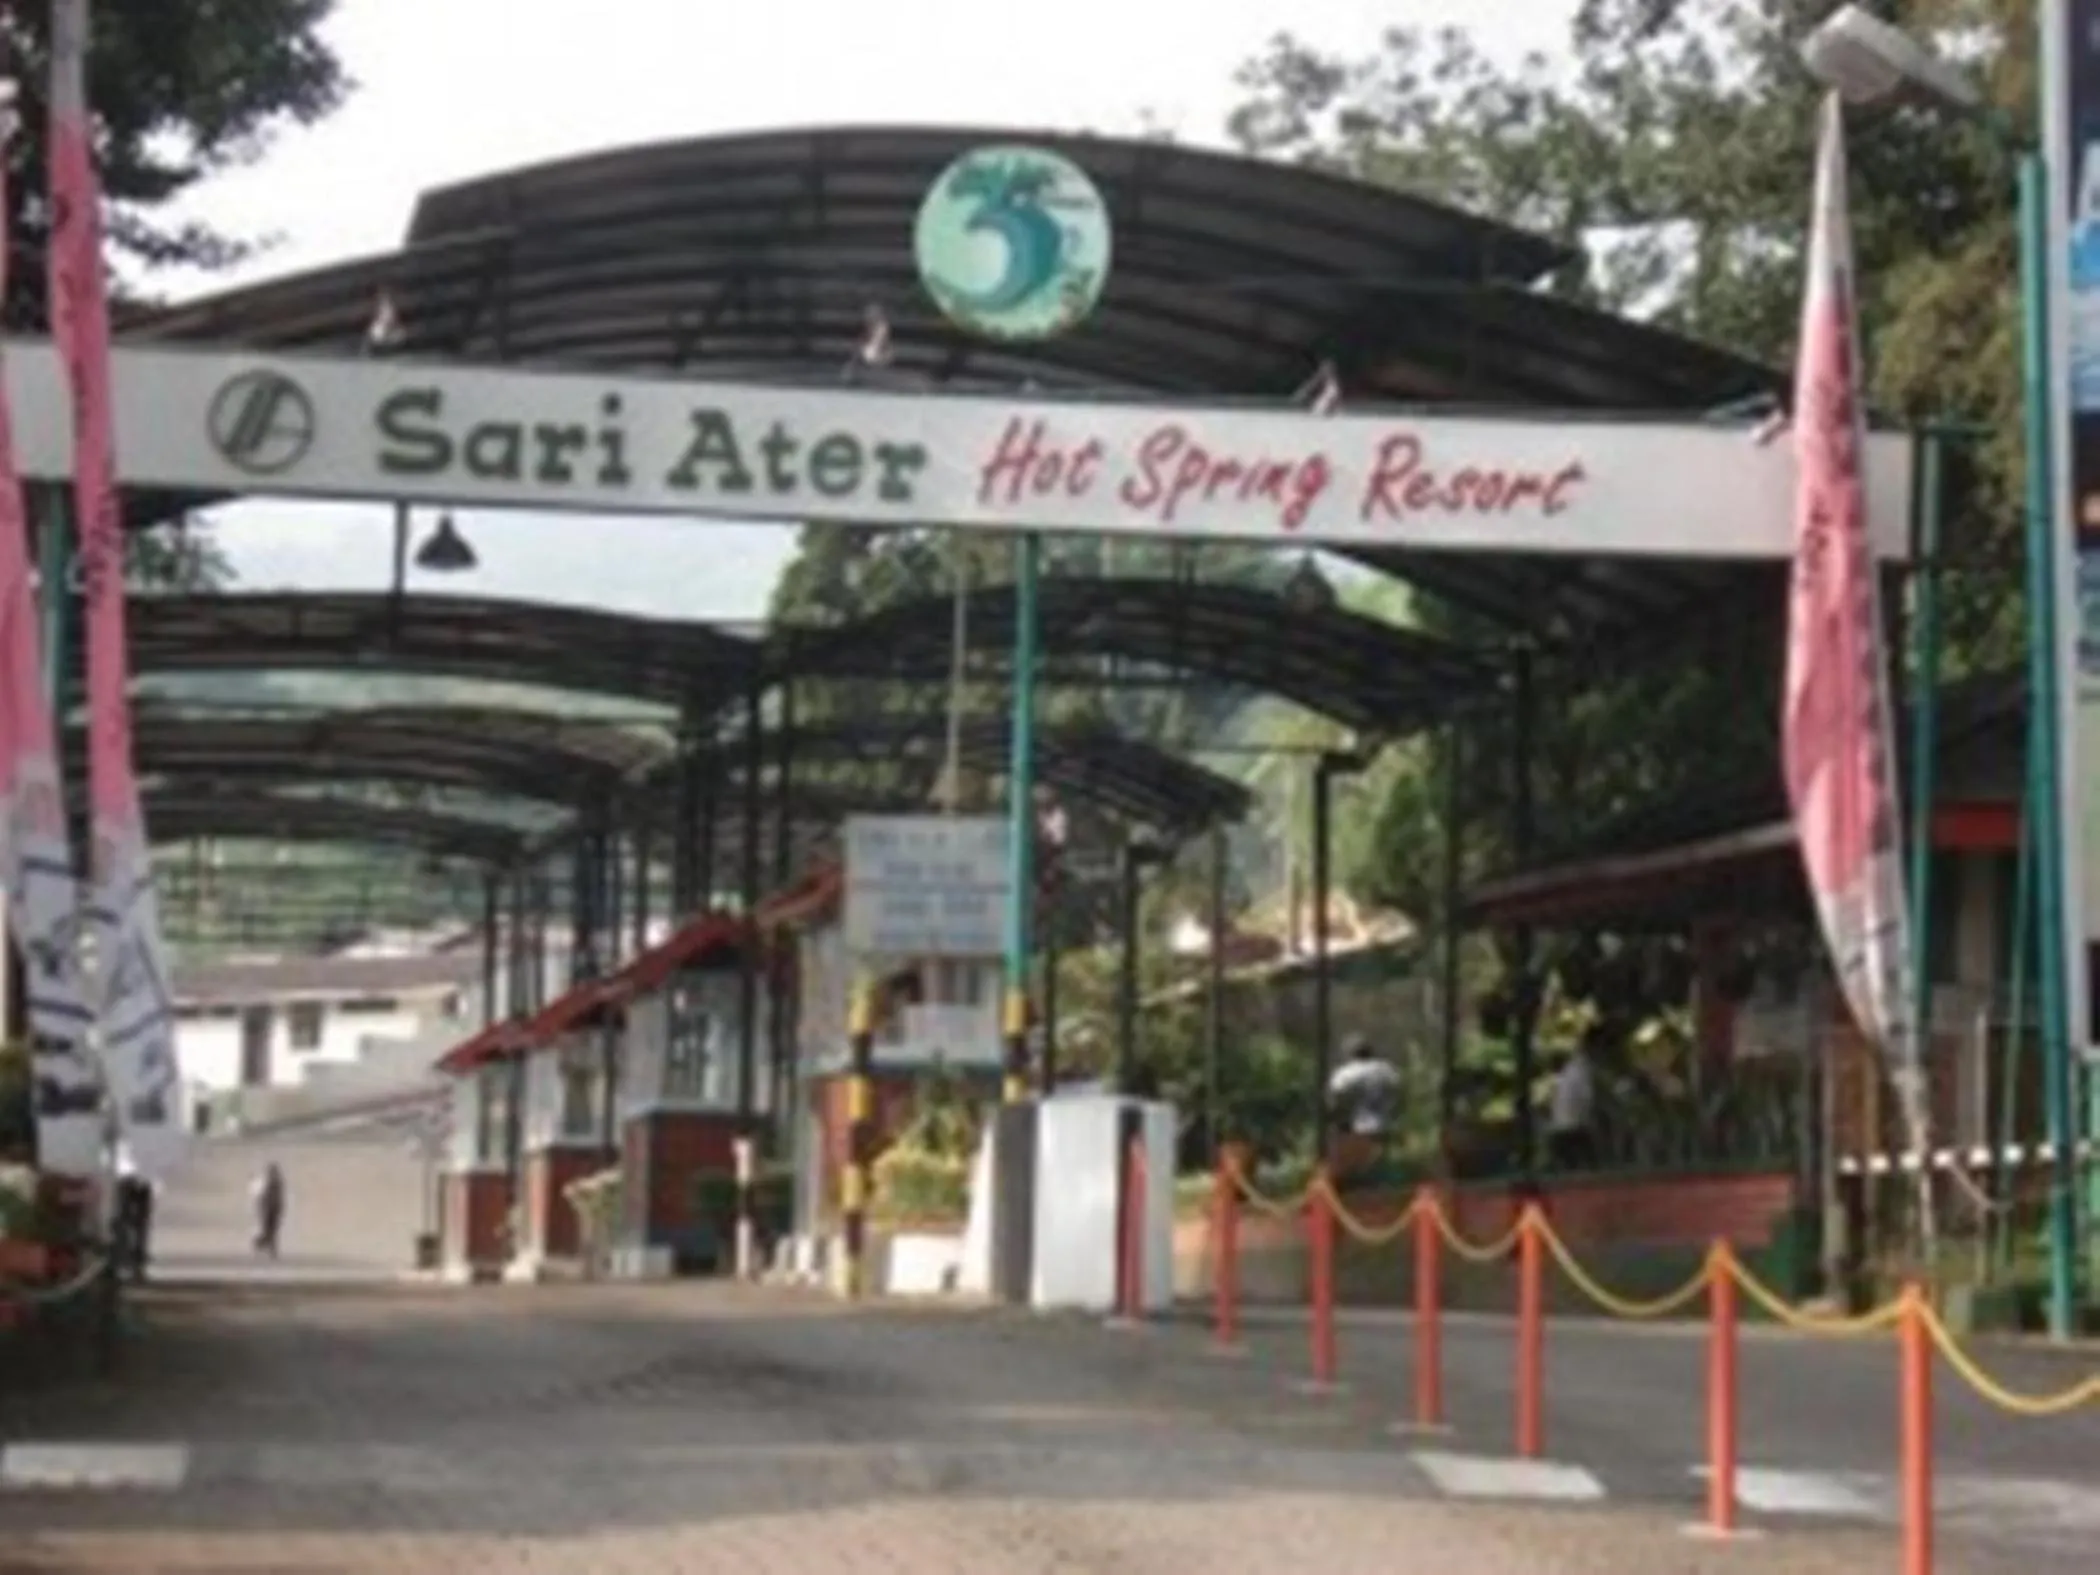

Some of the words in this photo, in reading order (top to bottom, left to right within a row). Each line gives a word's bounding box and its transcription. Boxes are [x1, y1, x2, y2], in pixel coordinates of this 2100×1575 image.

[374, 387, 632, 487] Sari
[666, 409, 930, 502] Ater
[978, 416, 1105, 504] Hot
[1121, 425, 1332, 529] Spring
[1361, 433, 1587, 520] Resort
